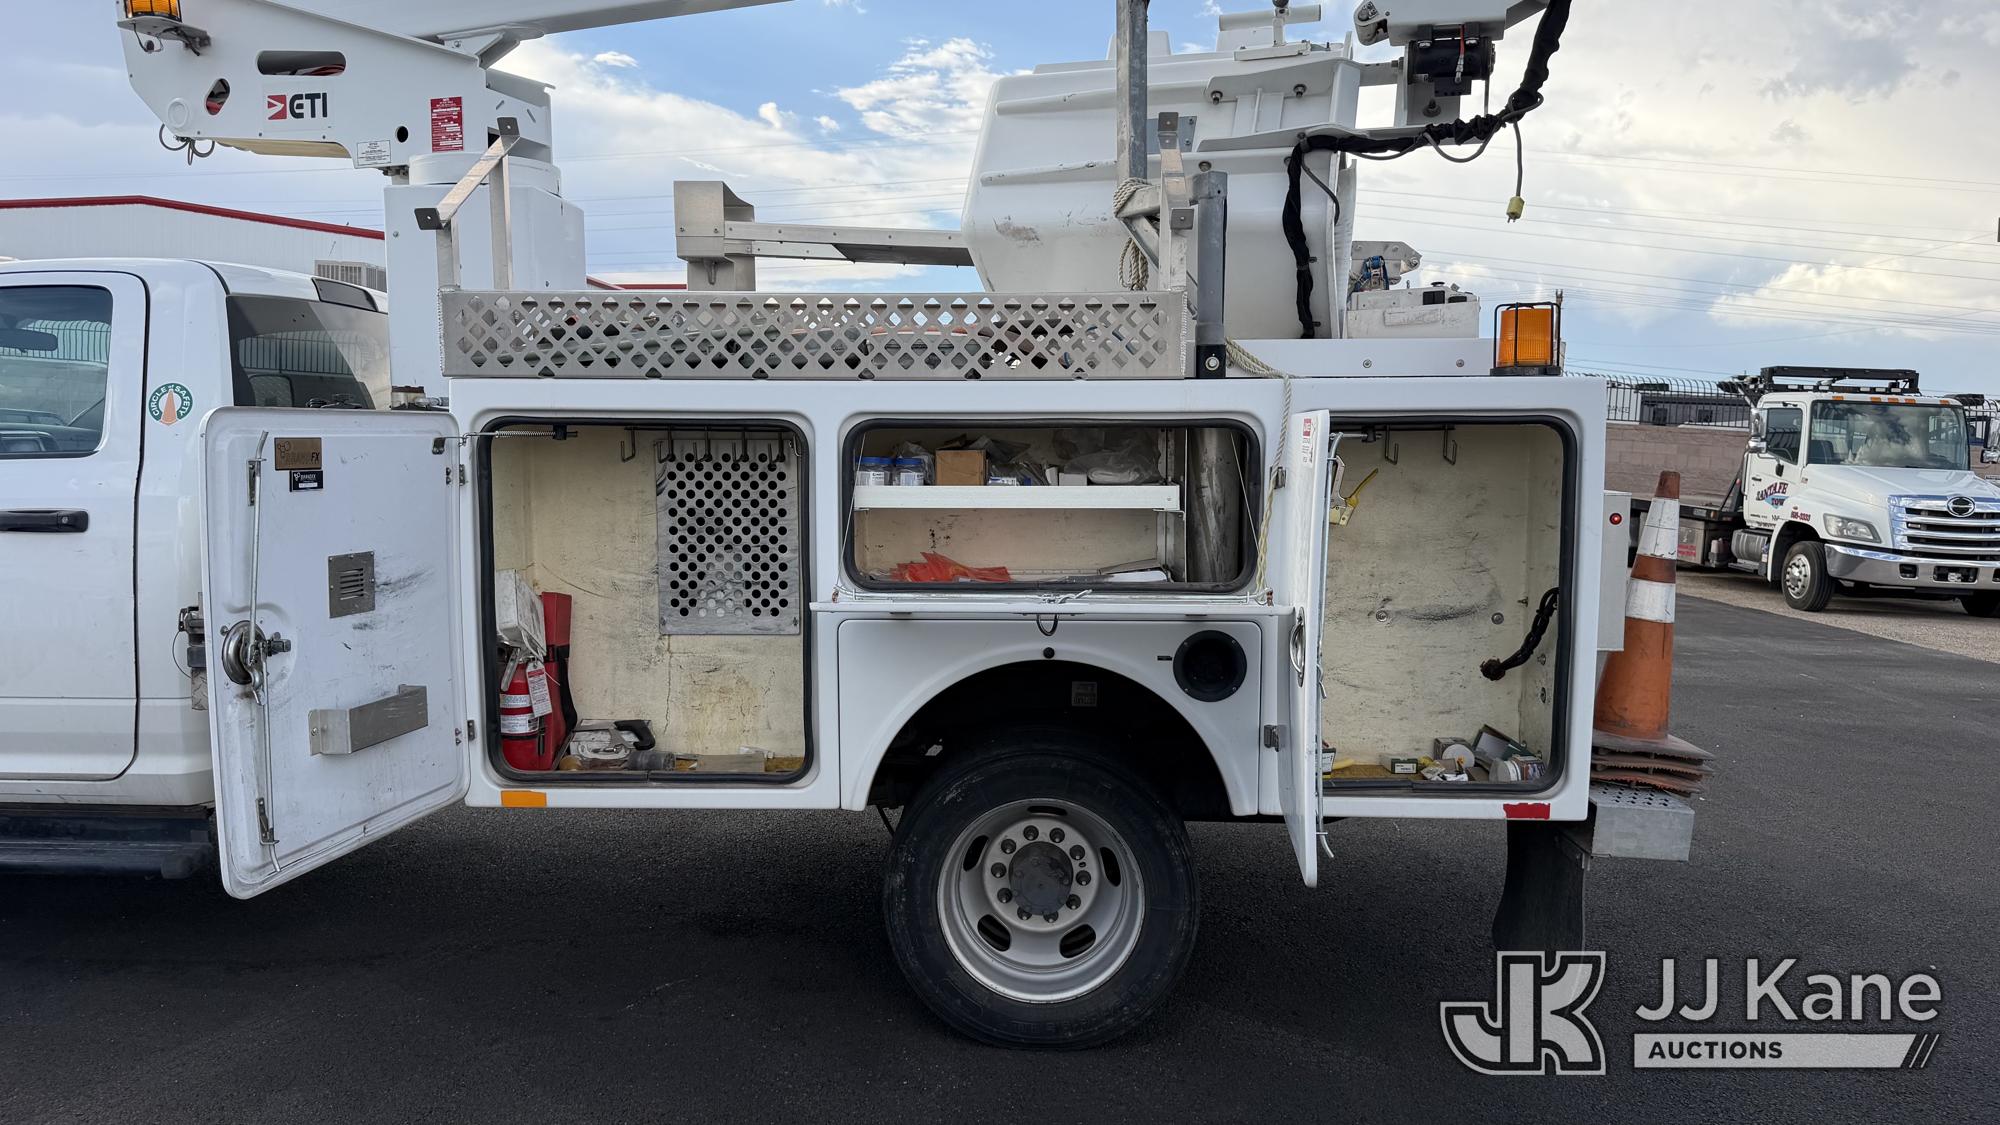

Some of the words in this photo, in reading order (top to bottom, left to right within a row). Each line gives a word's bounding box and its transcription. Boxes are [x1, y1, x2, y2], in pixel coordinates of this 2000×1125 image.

[289, 93, 327, 119] ETI
[151, 387, 168, 416] CIRCLE
[175, 385, 191, 416] SAFETY
[1771, 497, 1785, 506] TOW
